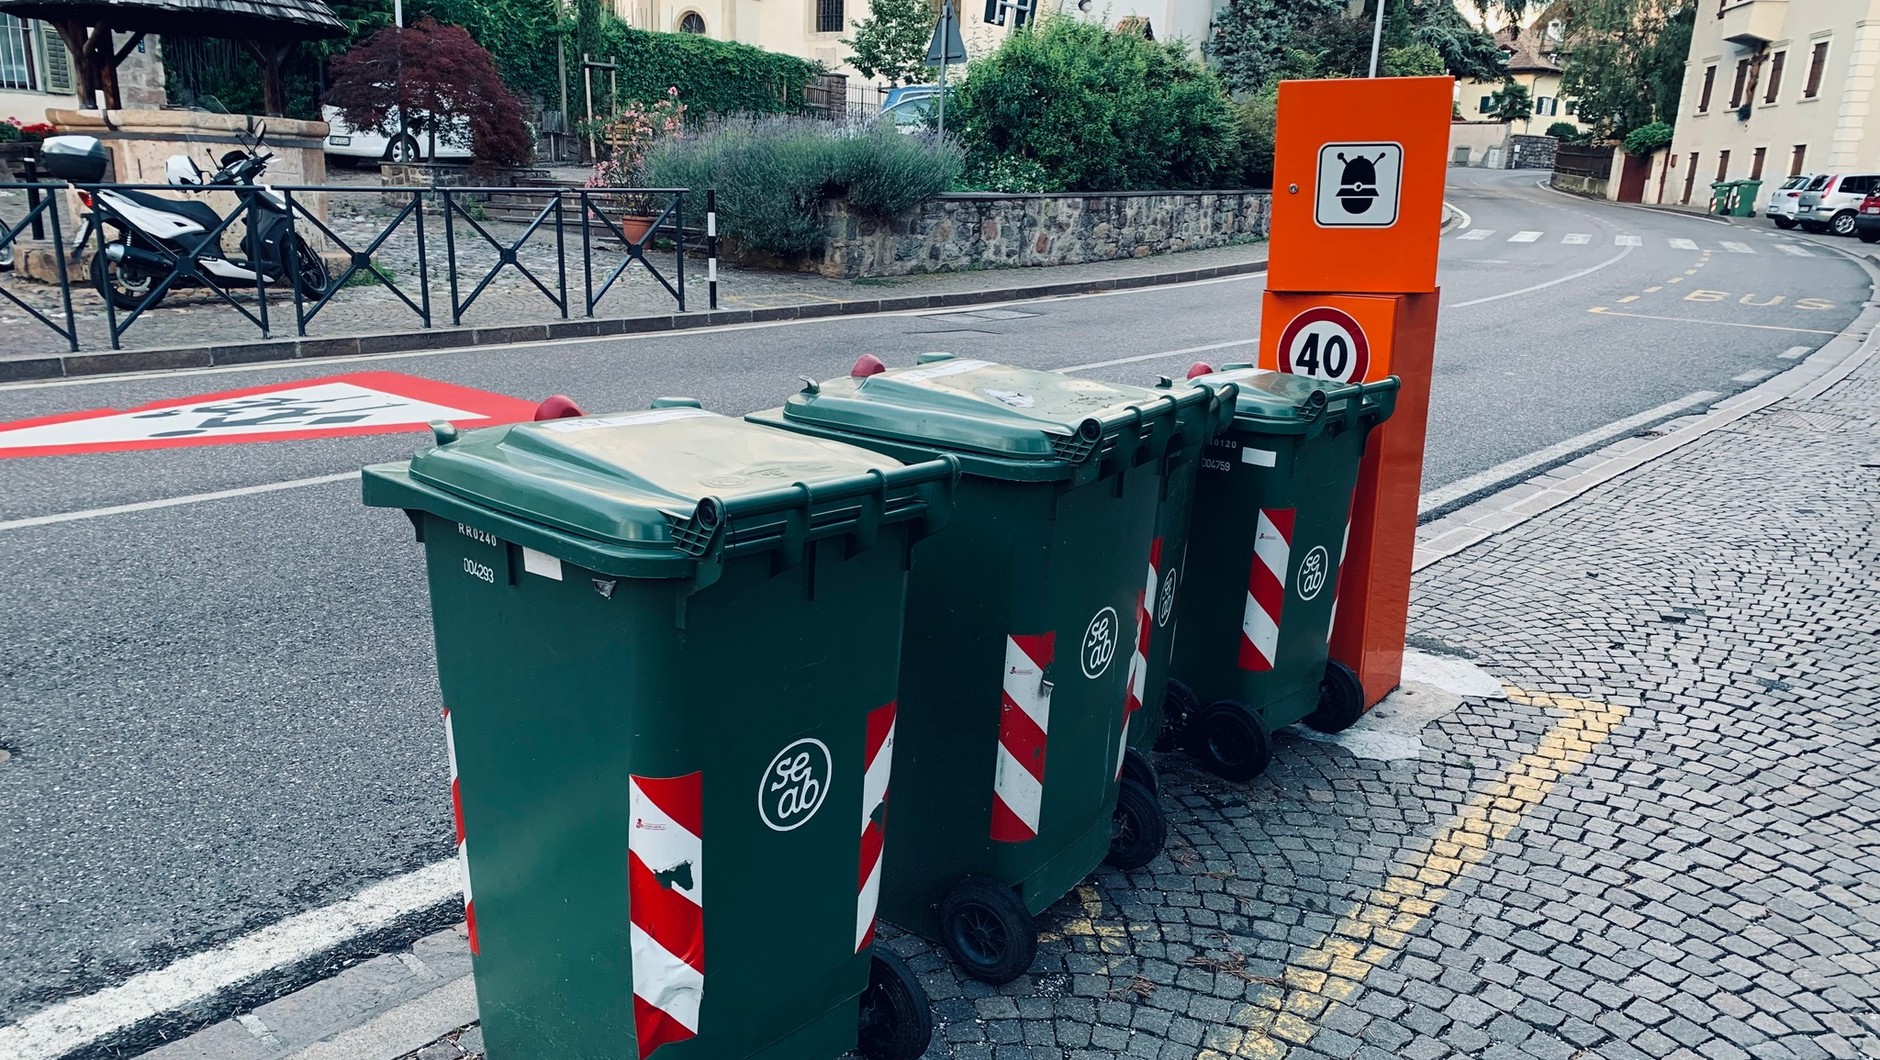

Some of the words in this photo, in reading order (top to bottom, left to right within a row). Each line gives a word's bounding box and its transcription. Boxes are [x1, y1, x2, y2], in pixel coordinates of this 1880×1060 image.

[1683, 289, 1836, 310] BUS
[1295, 333, 1348, 378] 40
[458, 522, 497, 547] RR0240
[463, 557, 494, 584] 004293
[1088, 617, 1109, 648] se
[1090, 636, 1112, 669] ab
[771, 751, 812, 792] se
[777, 774, 820, 819] ab
